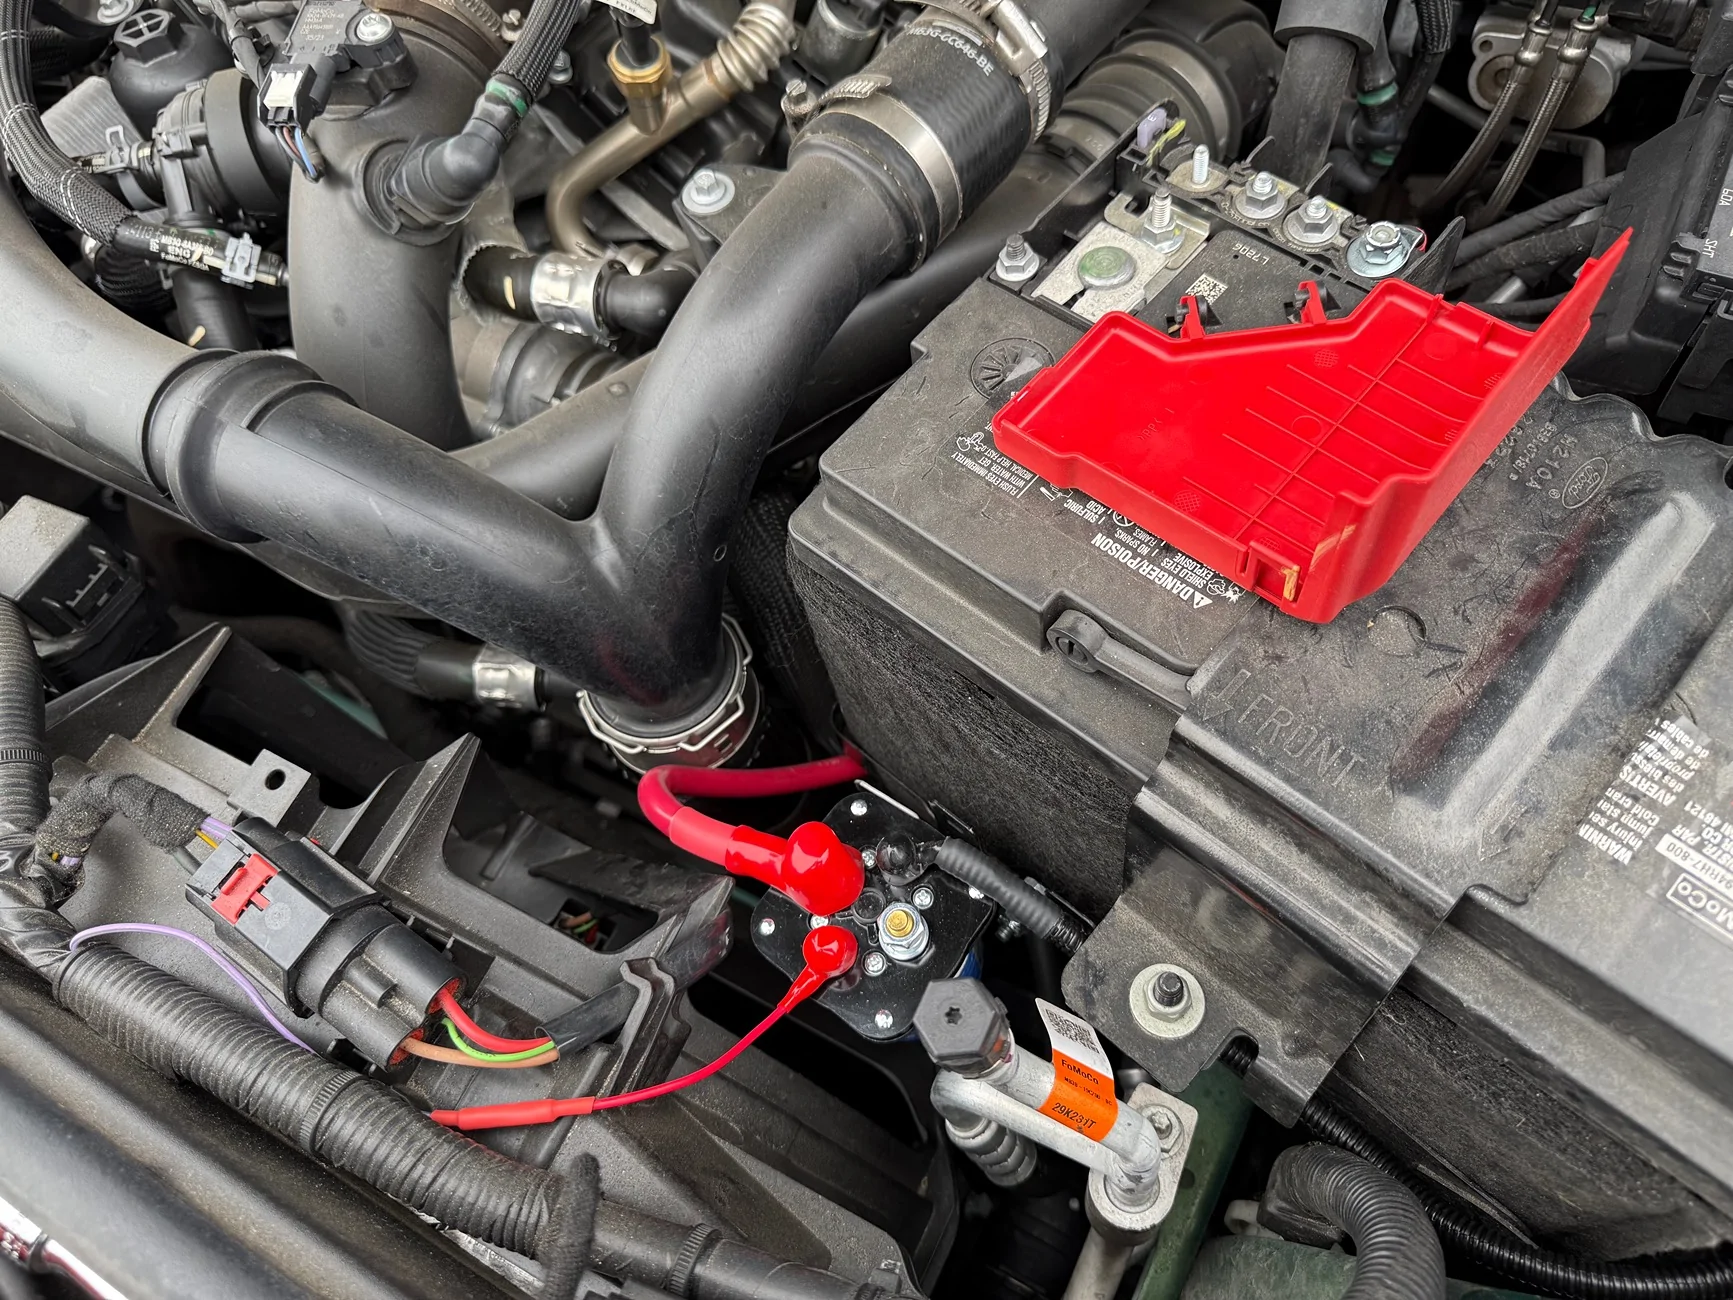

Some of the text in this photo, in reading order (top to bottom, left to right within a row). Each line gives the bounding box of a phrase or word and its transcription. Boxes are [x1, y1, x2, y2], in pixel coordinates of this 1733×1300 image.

[1702, 238, 1718, 259] SHT
[950, 450, 1019, 496] FLUSH EYES IMMEDIATELY
[977, 455, 1026, 488] WITH WATER. GET
[996, 454, 1012, 468] HELP
[1008, 462, 1033, 480] MEDICAL
[1566, 463, 1601, 499] Ford
[1062, 497, 1099, 523] SULFURIC
[1085, 498, 1106, 515] ACID
[1113, 526, 1140, 549] SPARKS,
[1136, 542, 1150, 556] NO
[1090, 531, 1195, 601] DANGER/POISON
[1159, 556, 1182, 574] EYES
[1172, 551, 1214, 580] EXPLOSIVE
[1178, 567, 1207, 588] SHIELD
[1237, 692, 1367, 788] FRONT
[1659, 718, 1695, 748] cables
[1683, 755, 1701, 769] de
[1692, 743, 1710, 759] de
[1661, 773, 1684, 792] des
[1629, 802, 1661, 827] Cold
[1682, 799, 1722, 826] 48121
[1605, 820, 1643, 851] injury
[1619, 813, 1654, 839] jump
[1670, 822, 1701, 846] PAR
[1699, 823, 1723, 845] CO.
[1061, 1059, 1098, 1084] FoMoCo
